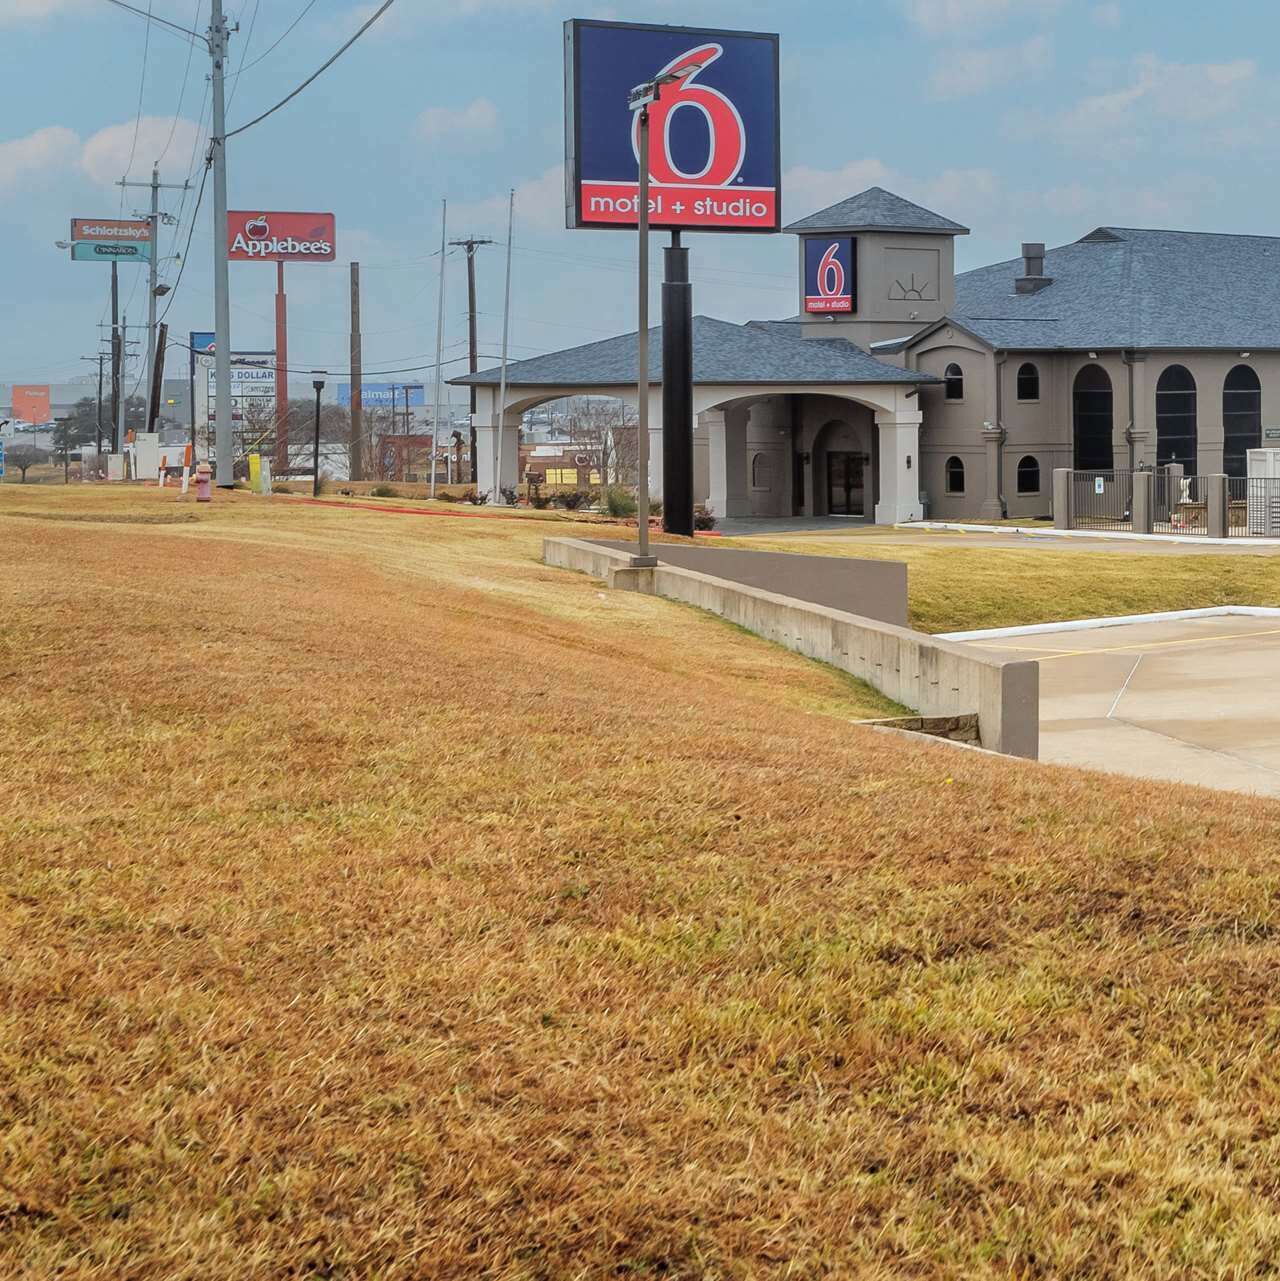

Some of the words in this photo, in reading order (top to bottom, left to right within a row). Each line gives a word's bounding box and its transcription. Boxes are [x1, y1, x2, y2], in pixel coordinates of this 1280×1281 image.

[631, 42, 746, 186] 6
[694, 197, 767, 217] studio
[82, 225, 149, 238] Schlotzsky's
[230, 233, 332, 257] Applebee's
[817, 242, 845, 297] 6
[238, 371, 274, 380] DOLLAR
[361, 390, 399, 399] almart
